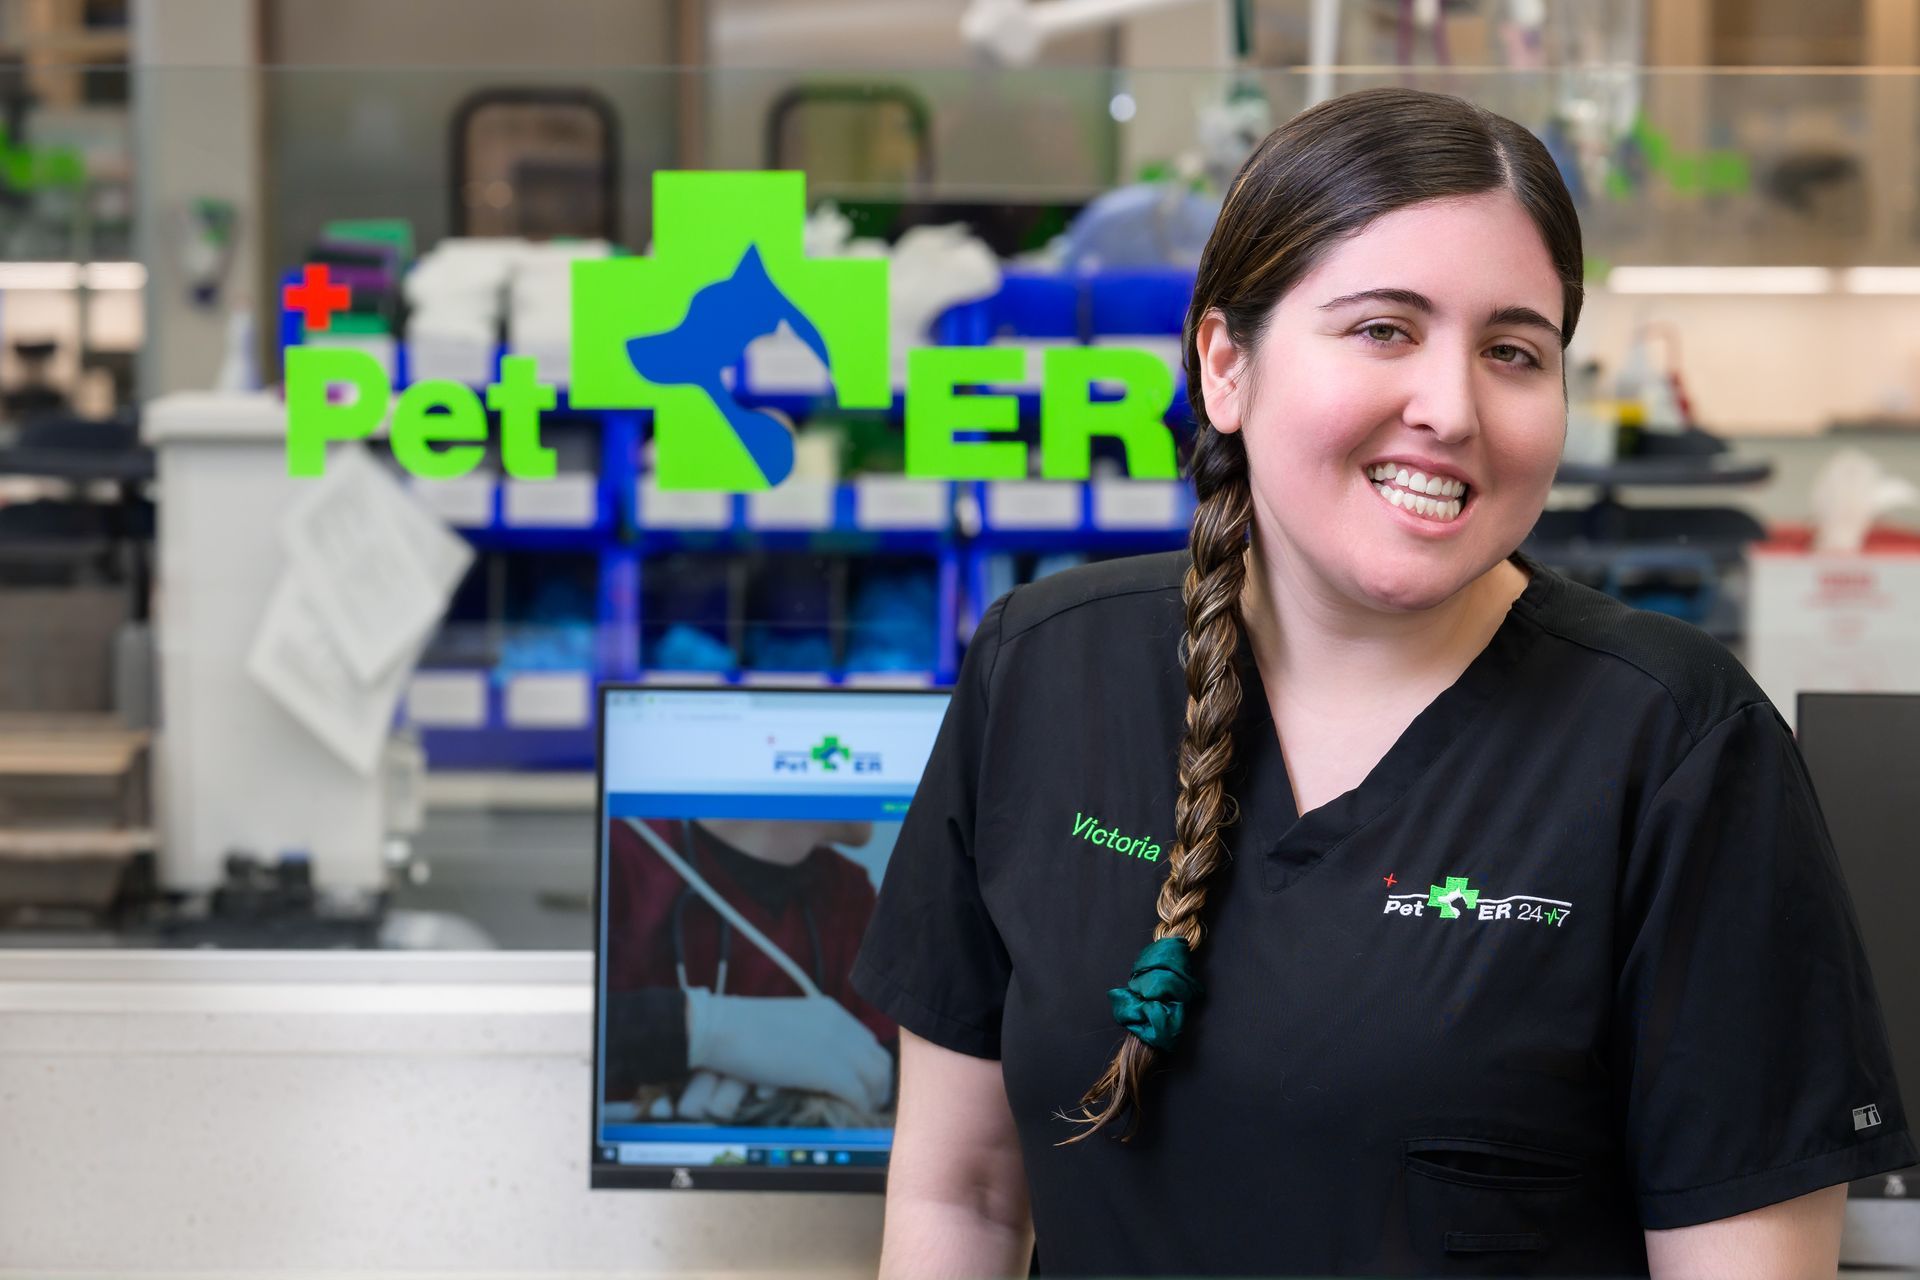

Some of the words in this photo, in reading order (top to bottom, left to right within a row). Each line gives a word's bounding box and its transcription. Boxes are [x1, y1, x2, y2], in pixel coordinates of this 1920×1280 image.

[284, 345, 558, 480] Pet
[905, 346, 1180, 480] ER
[1072, 812, 1161, 862] Victoria
[1384, 900, 1425, 917] Pet
[1478, 902, 1512, 920] ER
